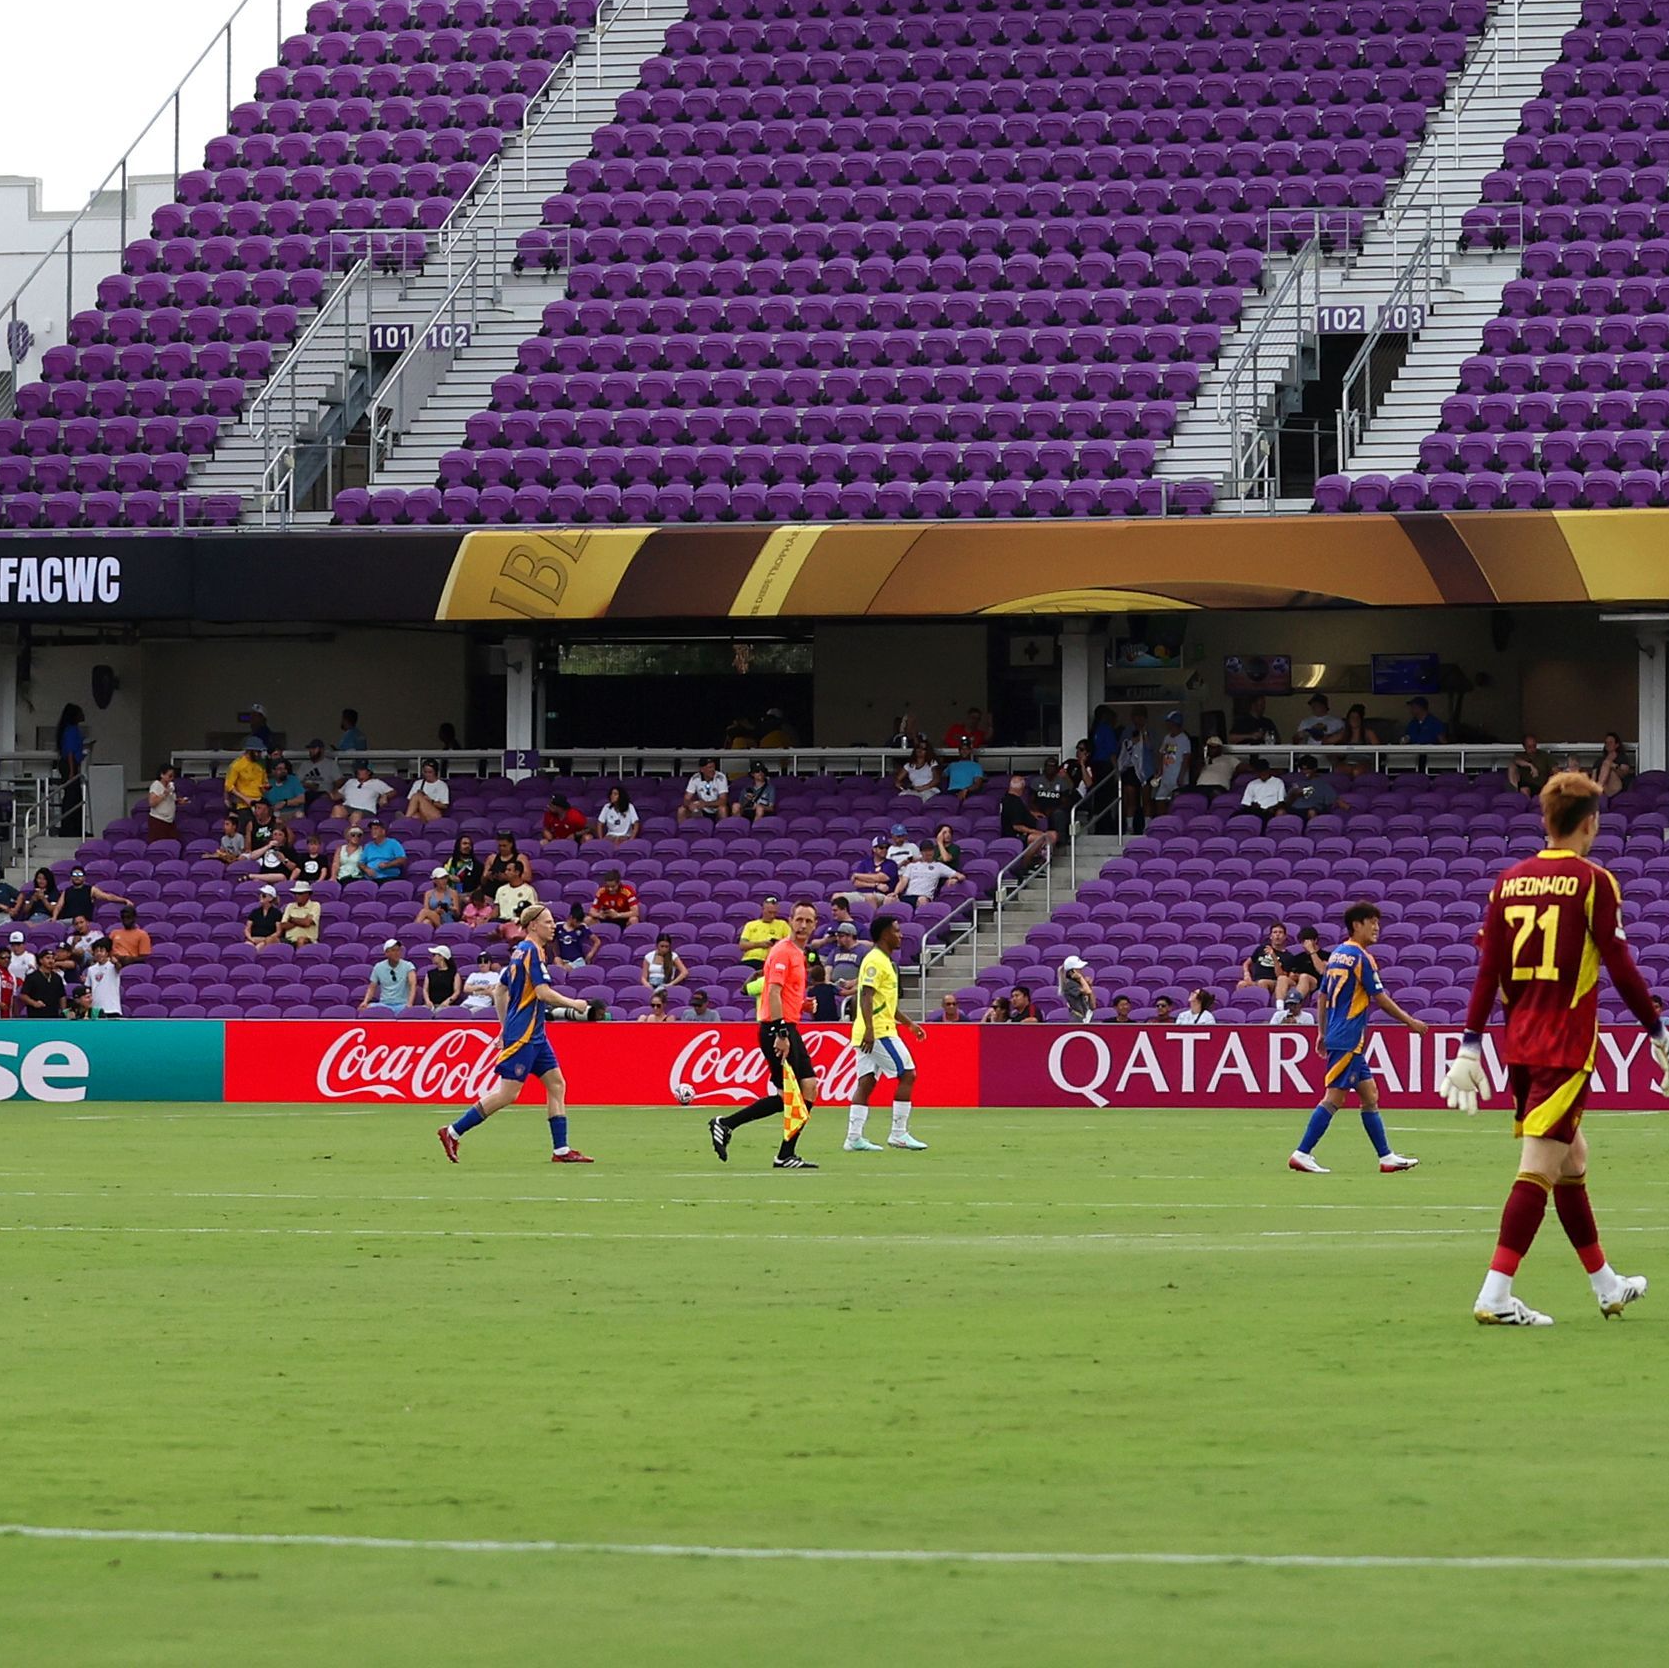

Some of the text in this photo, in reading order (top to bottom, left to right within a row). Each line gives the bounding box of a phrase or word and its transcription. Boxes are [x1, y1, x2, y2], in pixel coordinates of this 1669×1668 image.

[1320, 307, 1362, 331] 102
[373, 326, 410, 349] 101
[428, 325, 468, 348] 102
[517, 752, 526, 766] 2
[1500, 875, 1579, 899] HYEONWOO
[1504, 904, 1560, 981] 21
[670, 1030, 859, 1101] Cocaola
[1048, 1031, 1314, 1108] QATAR
